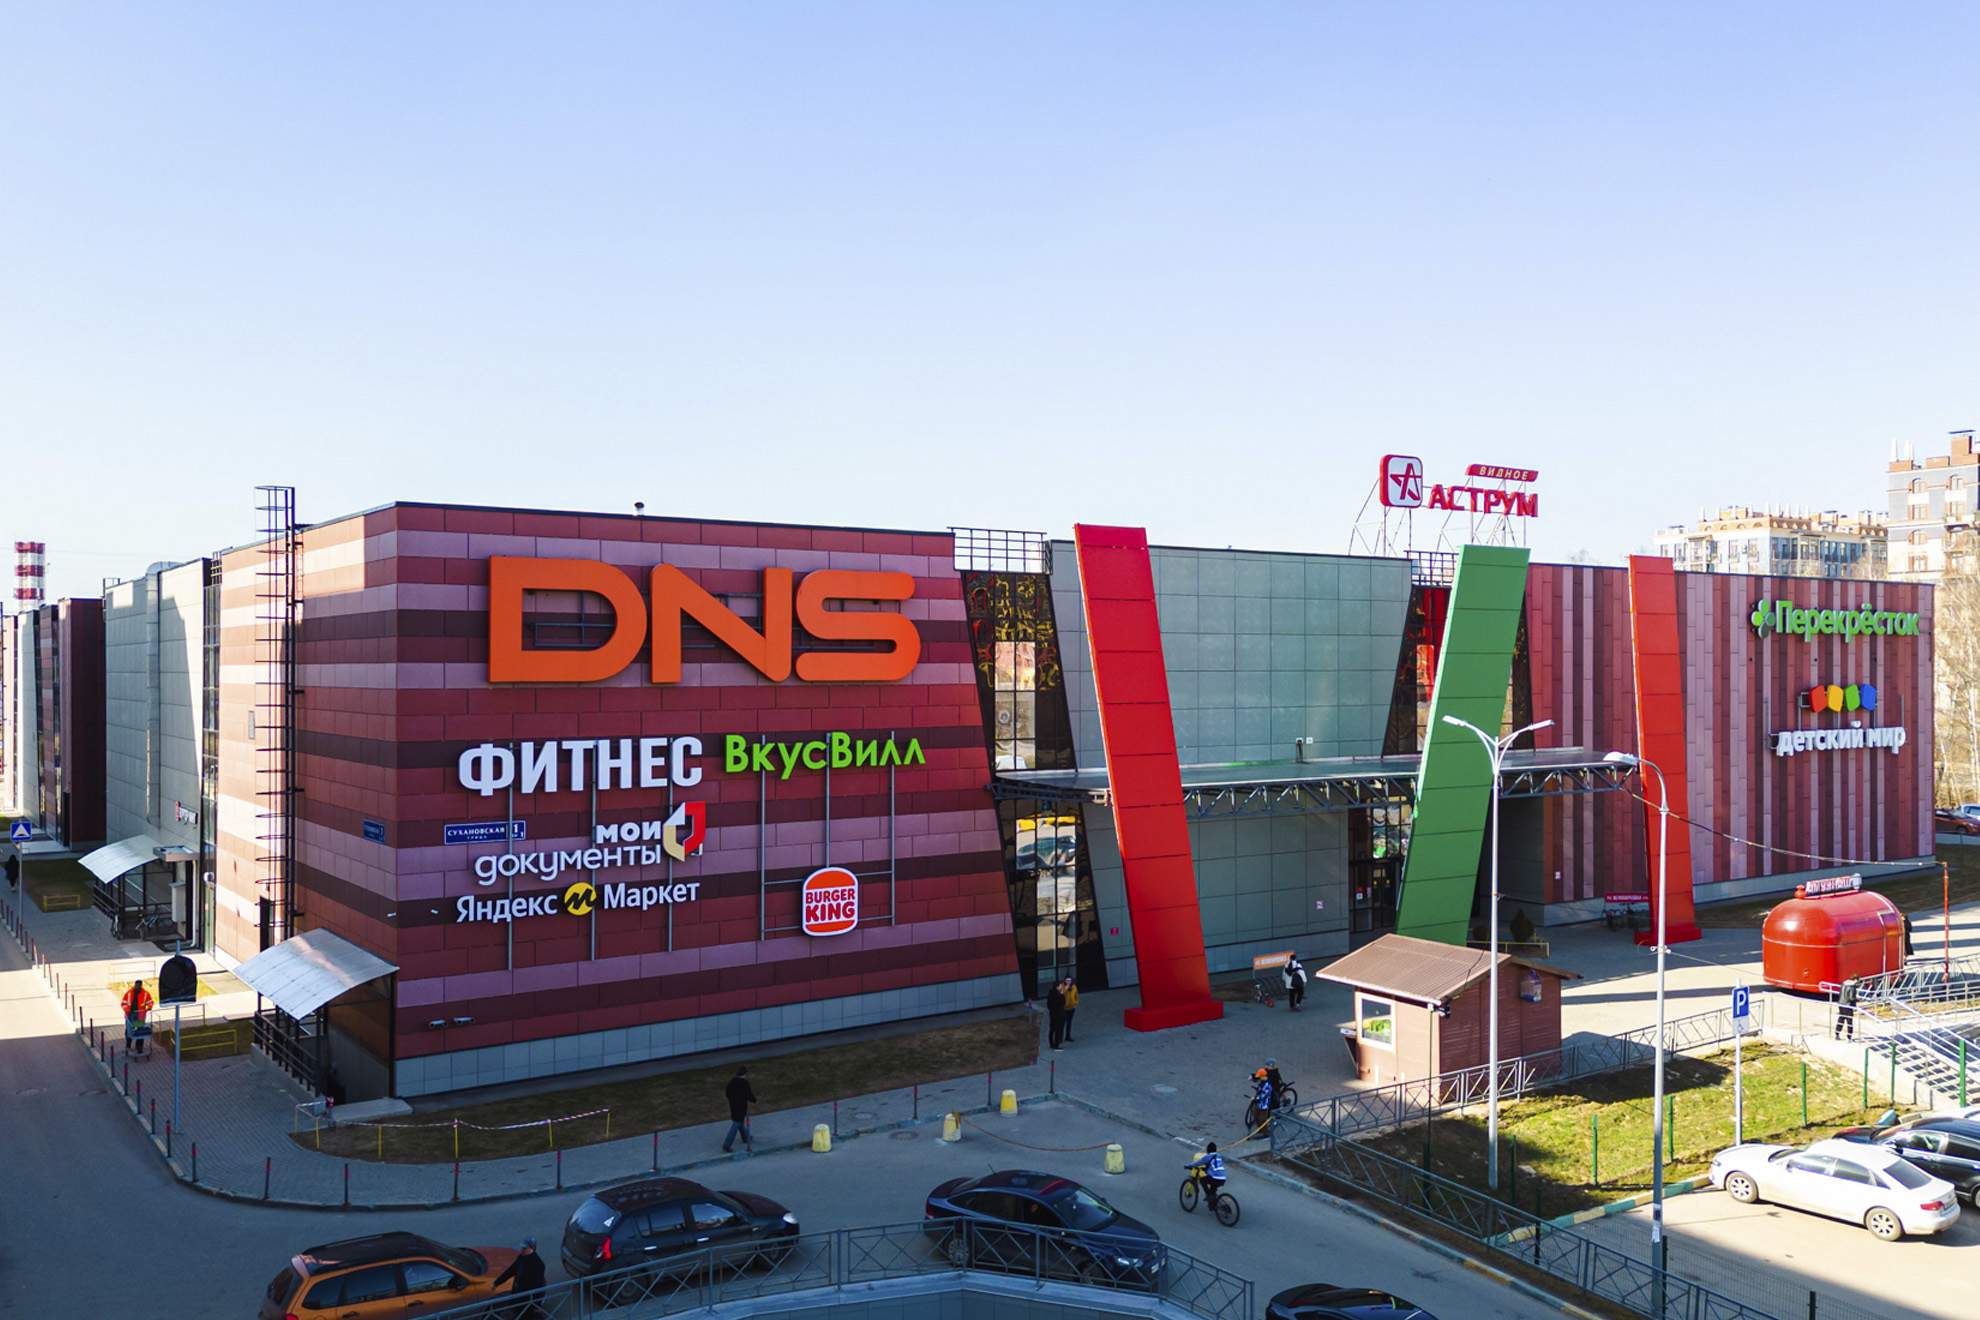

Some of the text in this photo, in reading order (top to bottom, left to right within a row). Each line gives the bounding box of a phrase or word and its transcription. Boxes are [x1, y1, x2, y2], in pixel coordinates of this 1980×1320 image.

[1479, 466, 1529, 481] ВИДНОЕ
[1429, 484, 1539, 517] АСТРУМ
[488, 556, 922, 683] DNS
[1775, 600, 1920, 643] Перекрёсток
[724, 731, 926, 779] ВкусВилл
[1776, 721, 1906, 757] детский мир
[458, 736, 703, 797] ФИТНЕС
[596, 818, 662, 845] мои
[475, 844, 662, 885] документы
[457, 892, 558, 924] Яндекс
[604, 882, 700, 910] Маркет
[805, 888, 856, 903] BURGER
[806, 902, 856, 923] KING
